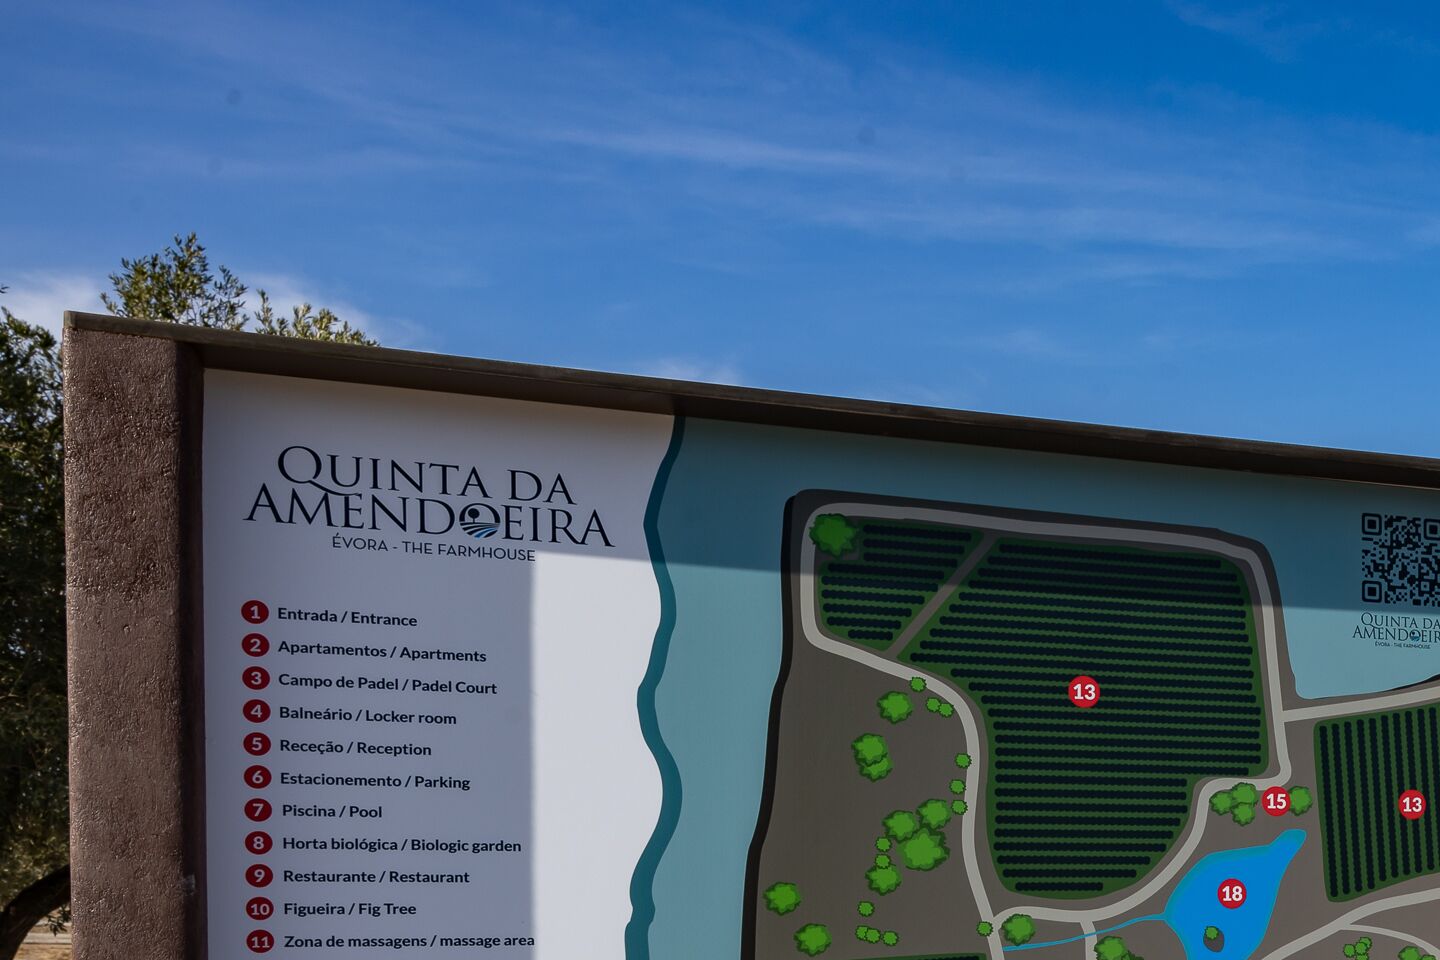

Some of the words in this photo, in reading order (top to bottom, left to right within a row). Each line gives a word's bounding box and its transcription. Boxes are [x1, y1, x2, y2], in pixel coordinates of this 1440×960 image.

[278, 446, 492, 499] QUINTA
[507, 470, 576, 505] DA
[242, 482, 615, 548] AMENDOEIRA
[332, 532, 388, 552] ÉVORA
[402, 541, 433, 554] THE
[438, 544, 535, 562] FARMHOUSE
[250, 605, 260, 619] 1
[278, 607, 338, 622] Entrada
[340, 610, 348, 623] /
[351, 612, 418, 626] Entrance
[1361, 612, 1418, 629] QUINTA
[250, 638, 261, 652] 2
[278, 640, 387, 657] Apartamentos
[390, 646, 397, 658] /
[400, 647, 486, 662] Apartments
[251, 671, 262, 685] 3
[278, 674, 332, 689] Campo
[336, 676, 354, 688] de
[358, 677, 398, 690] Padel
[402, 678, 409, 691] /
[412, 679, 452, 692] Padel
[455, 681, 497, 694] Court
[1073, 684, 1096, 700] 13
[250, 704, 262, 718] 4
[280, 706, 352, 720] Balneário
[355, 709, 362, 722] /
[366, 710, 415, 723] Locker
[418, 715, 456, 724] room
[252, 737, 262, 751] 5
[280, 739, 344, 755] Receção
[346, 741, 354, 754] /
[357, 742, 432, 757] Reception
[252, 770, 264, 784] 6
[280, 772, 402, 787] Estacionemento
[404, 775, 412, 788] /
[415, 776, 470, 791] Parking
[1266, 793, 1286, 809] 15
[1402, 797, 1422, 812] 13
[252, 803, 264, 817] 7
[282, 804, 336, 817] Piscina
[338, 805, 346, 818] /
[350, 806, 382, 818] Pool
[253, 836, 264, 850] 8
[283, 837, 327, 850] Horta
[331, 838, 398, 853] biológica
[400, 838, 408, 851] /
[411, 839, 469, 854] Biologic
[472, 840, 521, 854] garden
[254, 869, 265, 882] 9
[284, 870, 376, 882] Restaurante
[378, 870, 386, 883] /
[389, 871, 470, 883] Restaurant
[1222, 886, 1243, 902] 18
[251, 904, 270, 915] 10
[284, 903, 345, 918] Figueira
[348, 902, 356, 916] /
[359, 903, 381, 917] Fig
[383, 903, 416, 915] Tree
[252, 936, 270, 948] 11
[284, 936, 322, 948] Zona
[326, 935, 344, 947] de
[348, 938, 427, 949] massagens
[430, 934, 437, 947] /
[440, 938, 501, 948] massage
[504, 937, 534, 946] area
